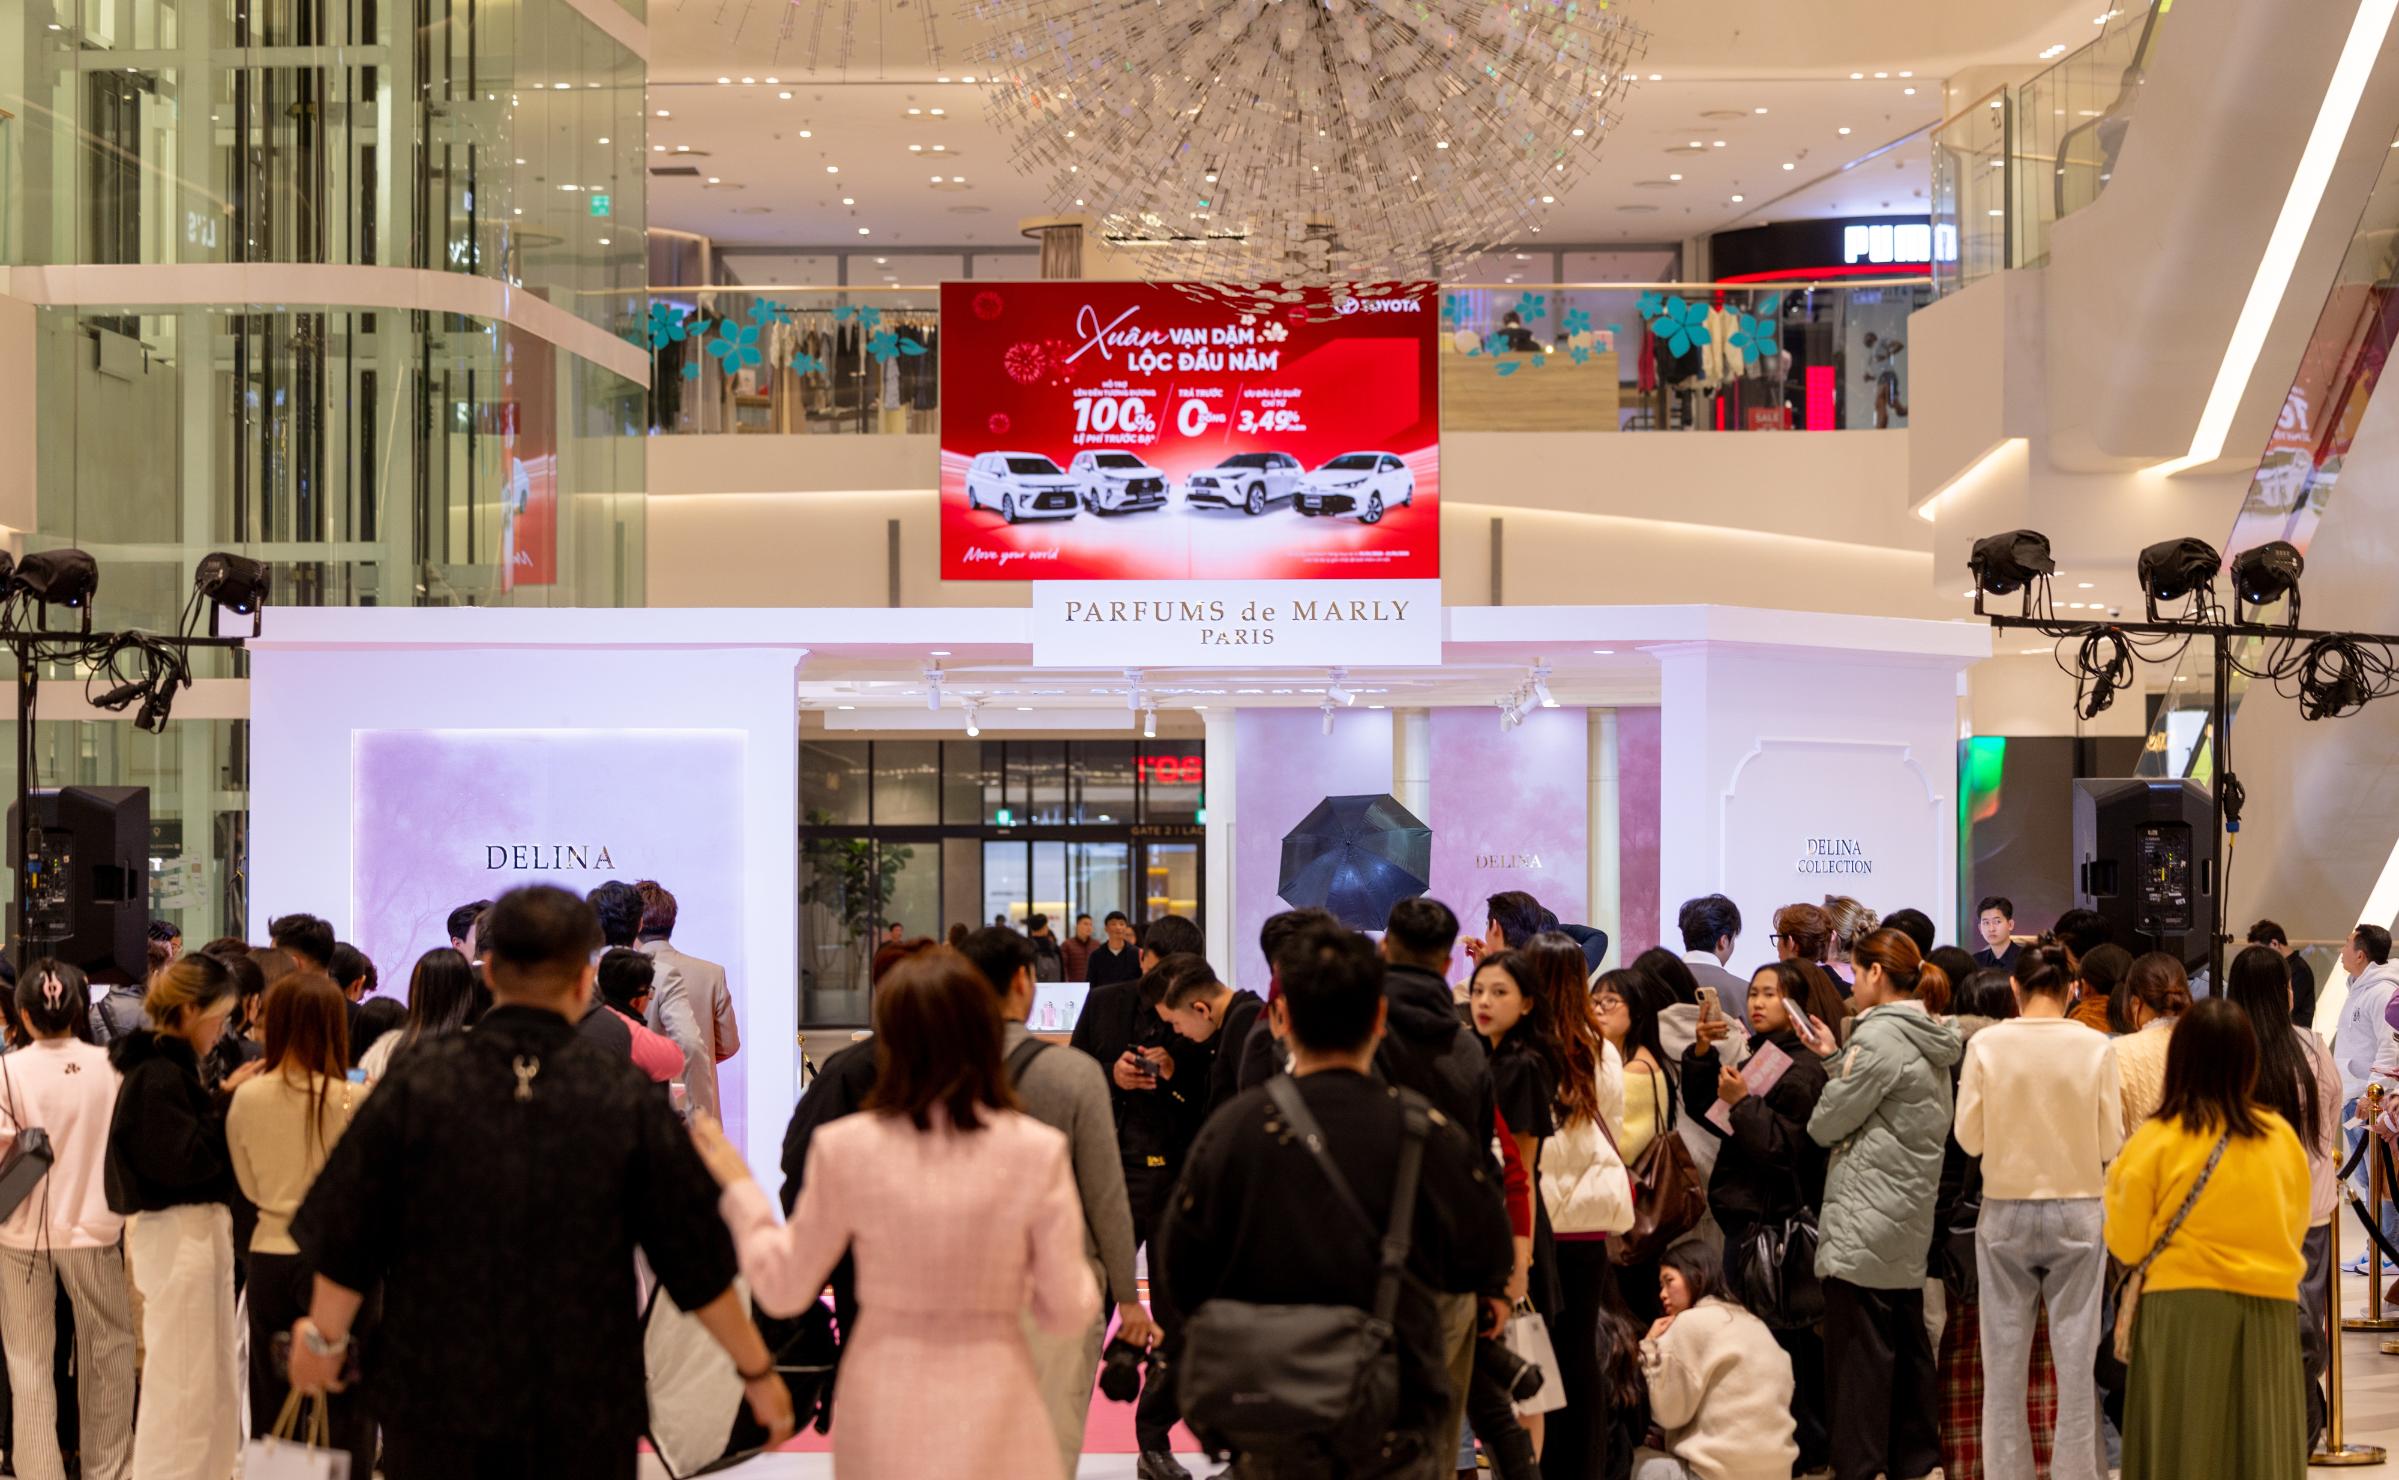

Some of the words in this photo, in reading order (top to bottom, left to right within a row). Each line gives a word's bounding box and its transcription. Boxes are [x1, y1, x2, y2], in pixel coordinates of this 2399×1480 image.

[1844, 224, 1957, 263] PUMA
[1064, 304, 1168, 364] Xuân
[1169, 328, 1207, 349] VẠN
[1211, 324, 1254, 349] DẶM
[1128, 348, 1173, 376] LỘC
[1229, 348, 1279, 371] NĂM
[1073, 397, 1156, 433] 100%
[963, 547, 998, 563] Move
[999, 552, 1027, 567] your
[1028, 547, 1060, 560] world
[1065, 601, 1224, 621] PARFUMS
[1241, 601, 1275, 621] de
[1292, 601, 1409, 621] MARLY
[1200, 628, 1275, 645] PARIS
[1130, 825, 1161, 836] GATE
[1807, 838, 1862, 855] DELINA
[485, 845, 616, 870] DELINA
[1475, 854, 1543, 869] DELINA
[1798, 859, 1872, 873] COLLECTION
